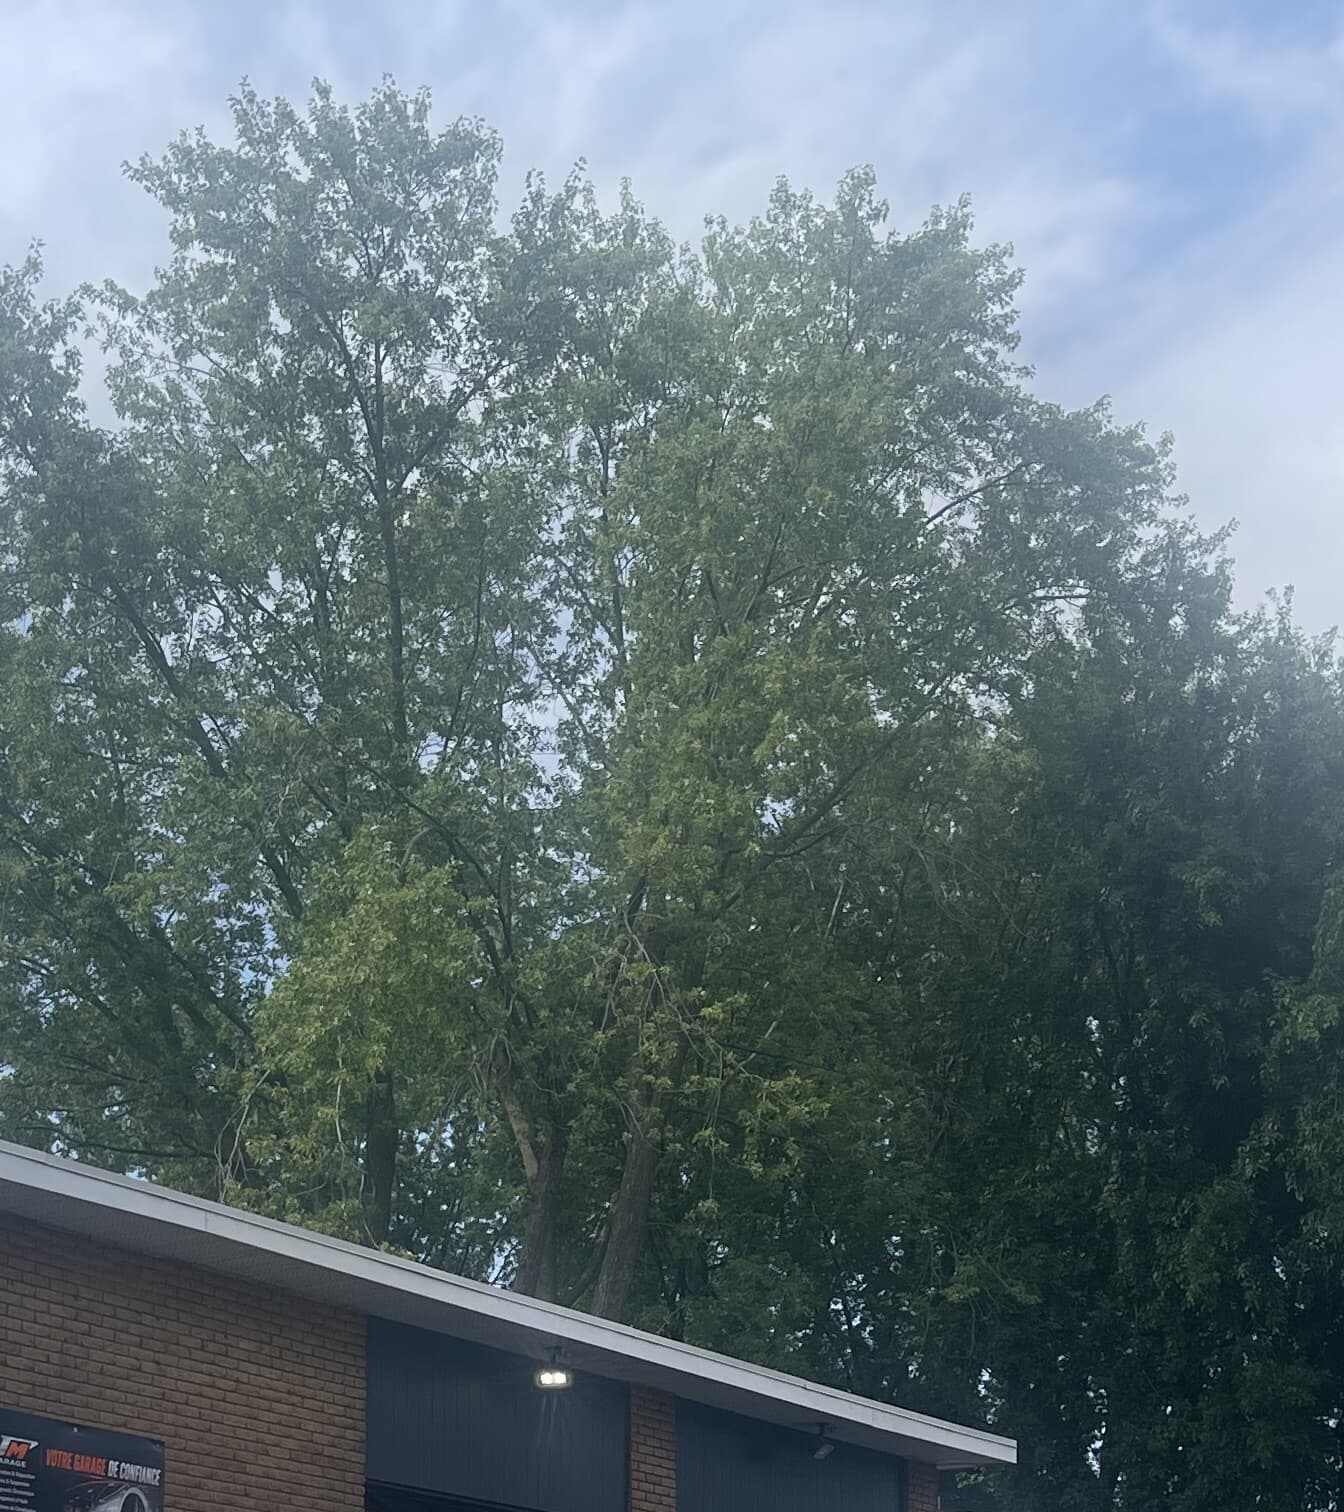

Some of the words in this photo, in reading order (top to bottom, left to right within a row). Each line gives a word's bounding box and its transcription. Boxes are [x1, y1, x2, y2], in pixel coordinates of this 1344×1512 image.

[46, 1448, 72, 1470] VOTRE
[73, 1454, 107, 1476] GARAGE
[107, 1460, 120, 1478] DE
[120, 1462, 161, 1486] CONFIANCE
